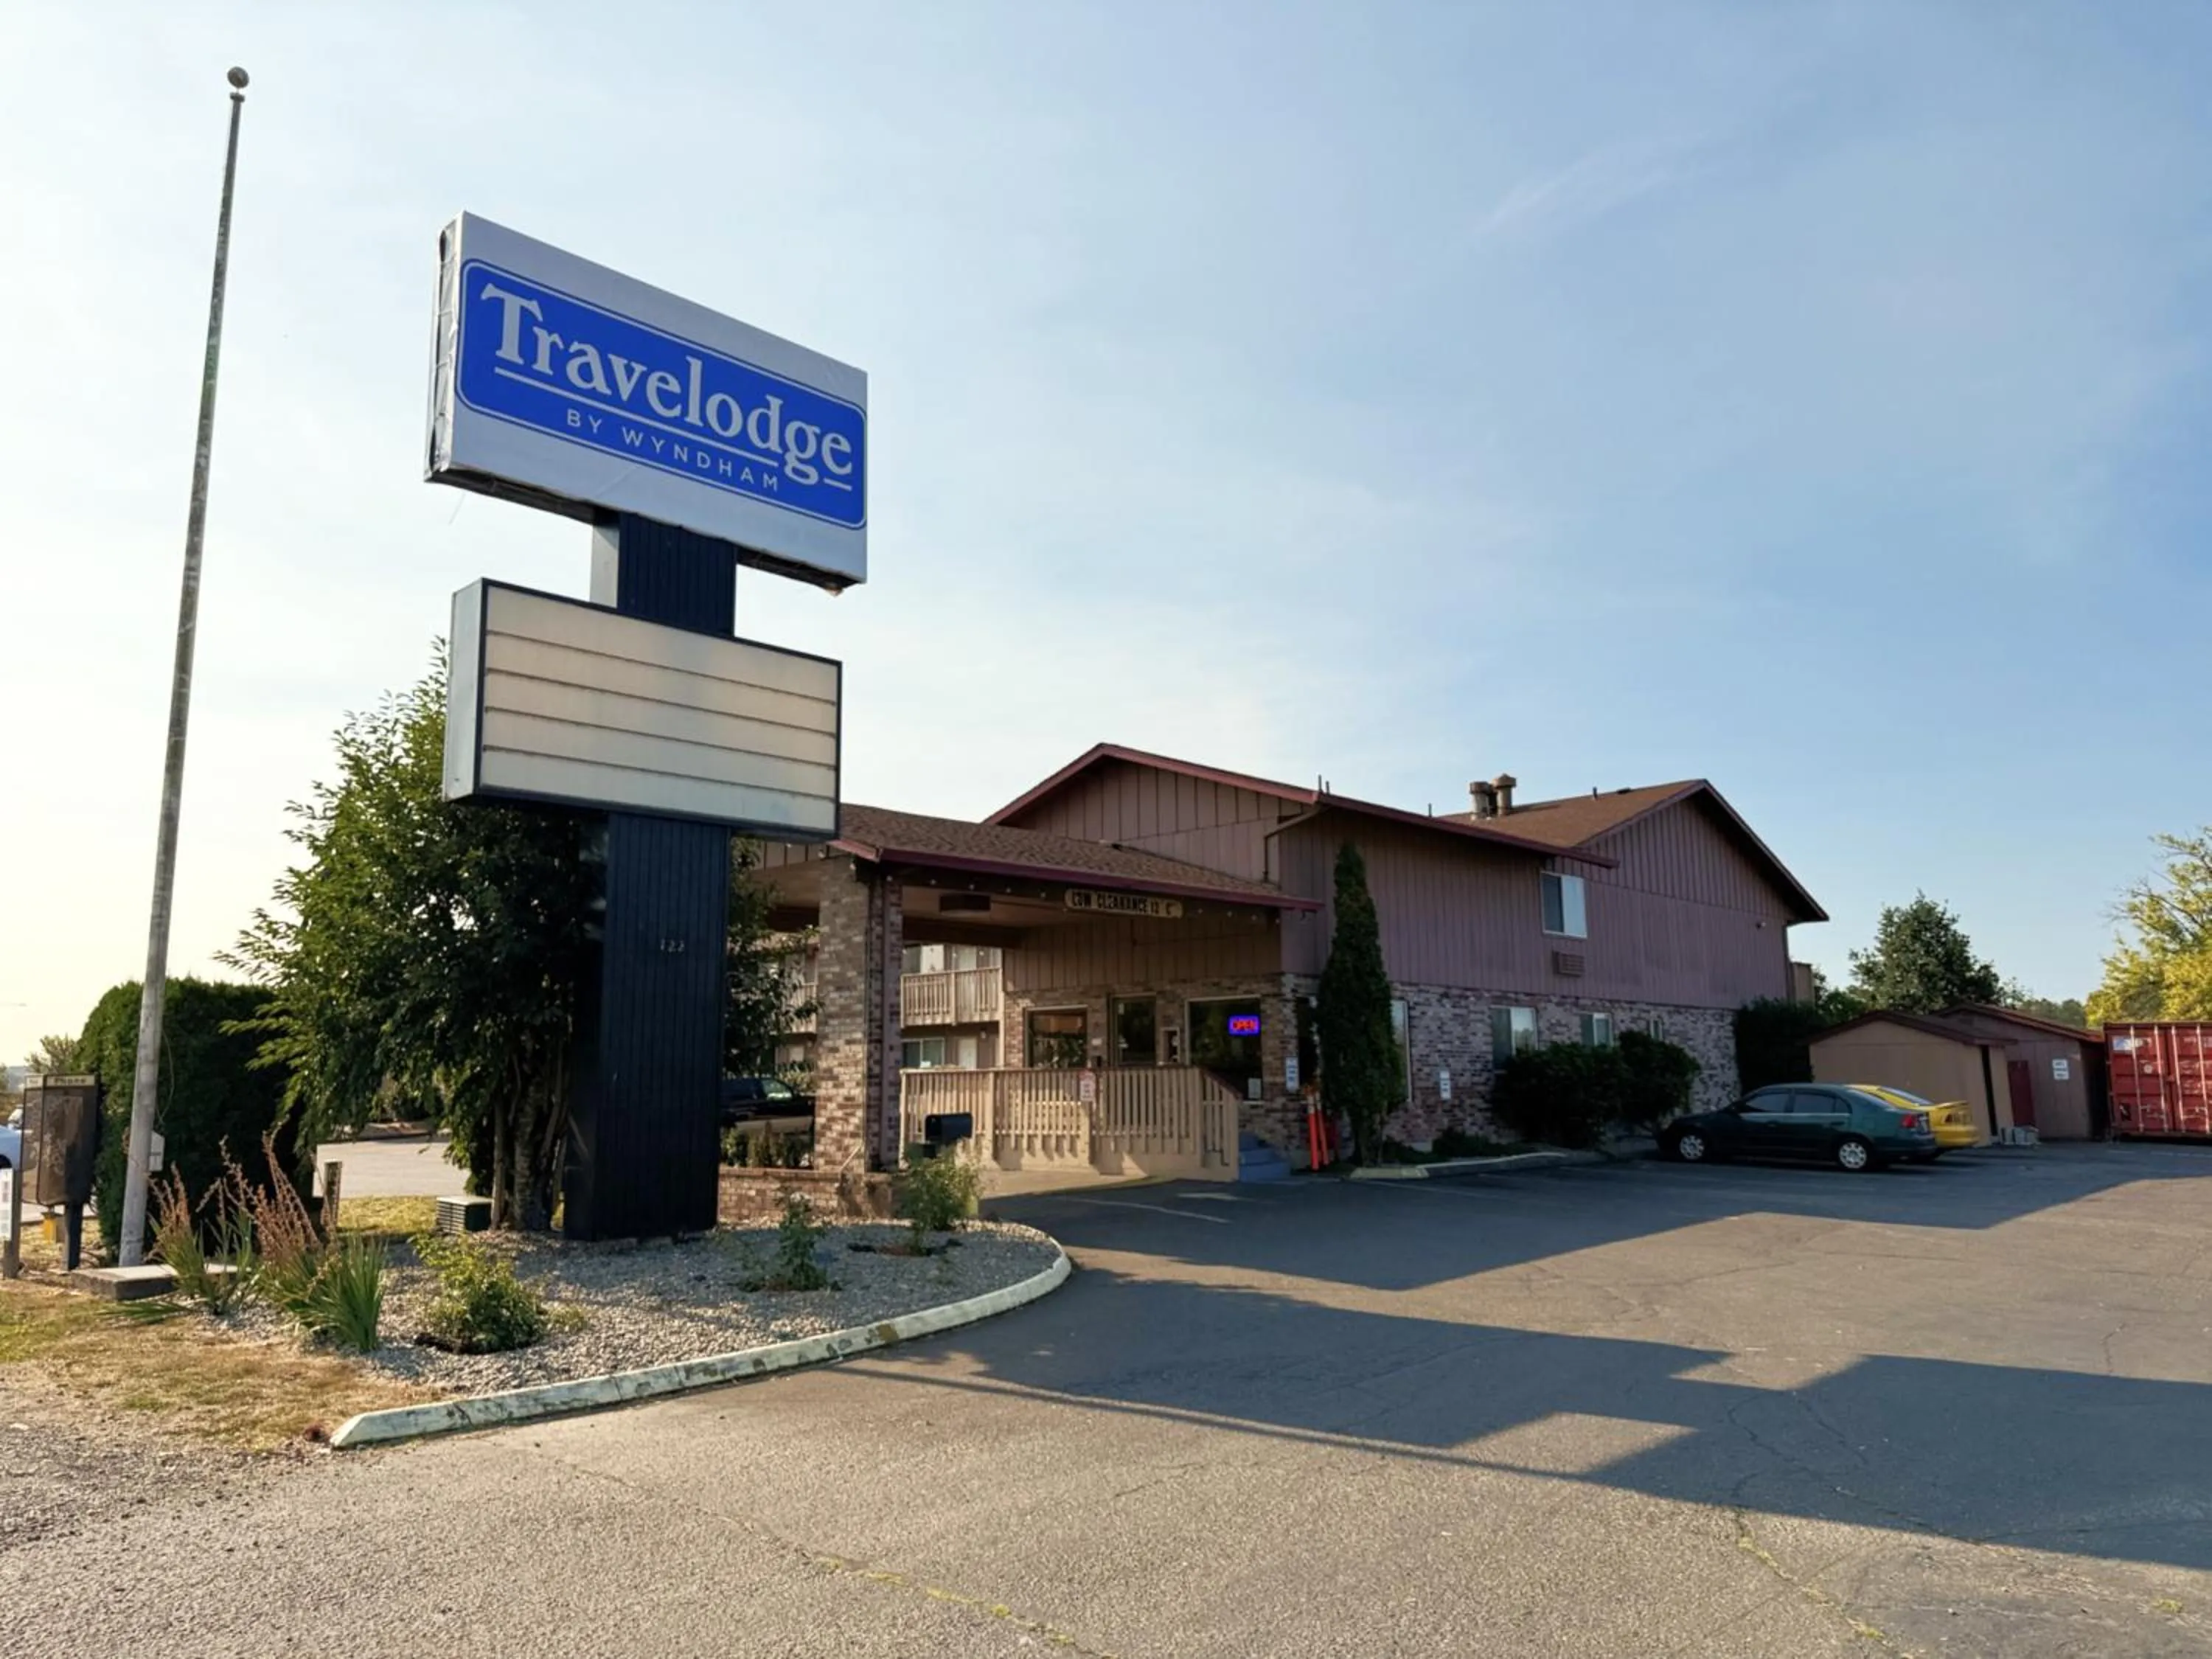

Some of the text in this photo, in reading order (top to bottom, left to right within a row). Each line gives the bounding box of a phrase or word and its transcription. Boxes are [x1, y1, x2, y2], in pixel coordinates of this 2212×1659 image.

[481, 282, 853, 486] Travelodge
[566, 408, 779, 492] BY WYNDHAM
[1232, 1020, 1257, 1031] OPEN
